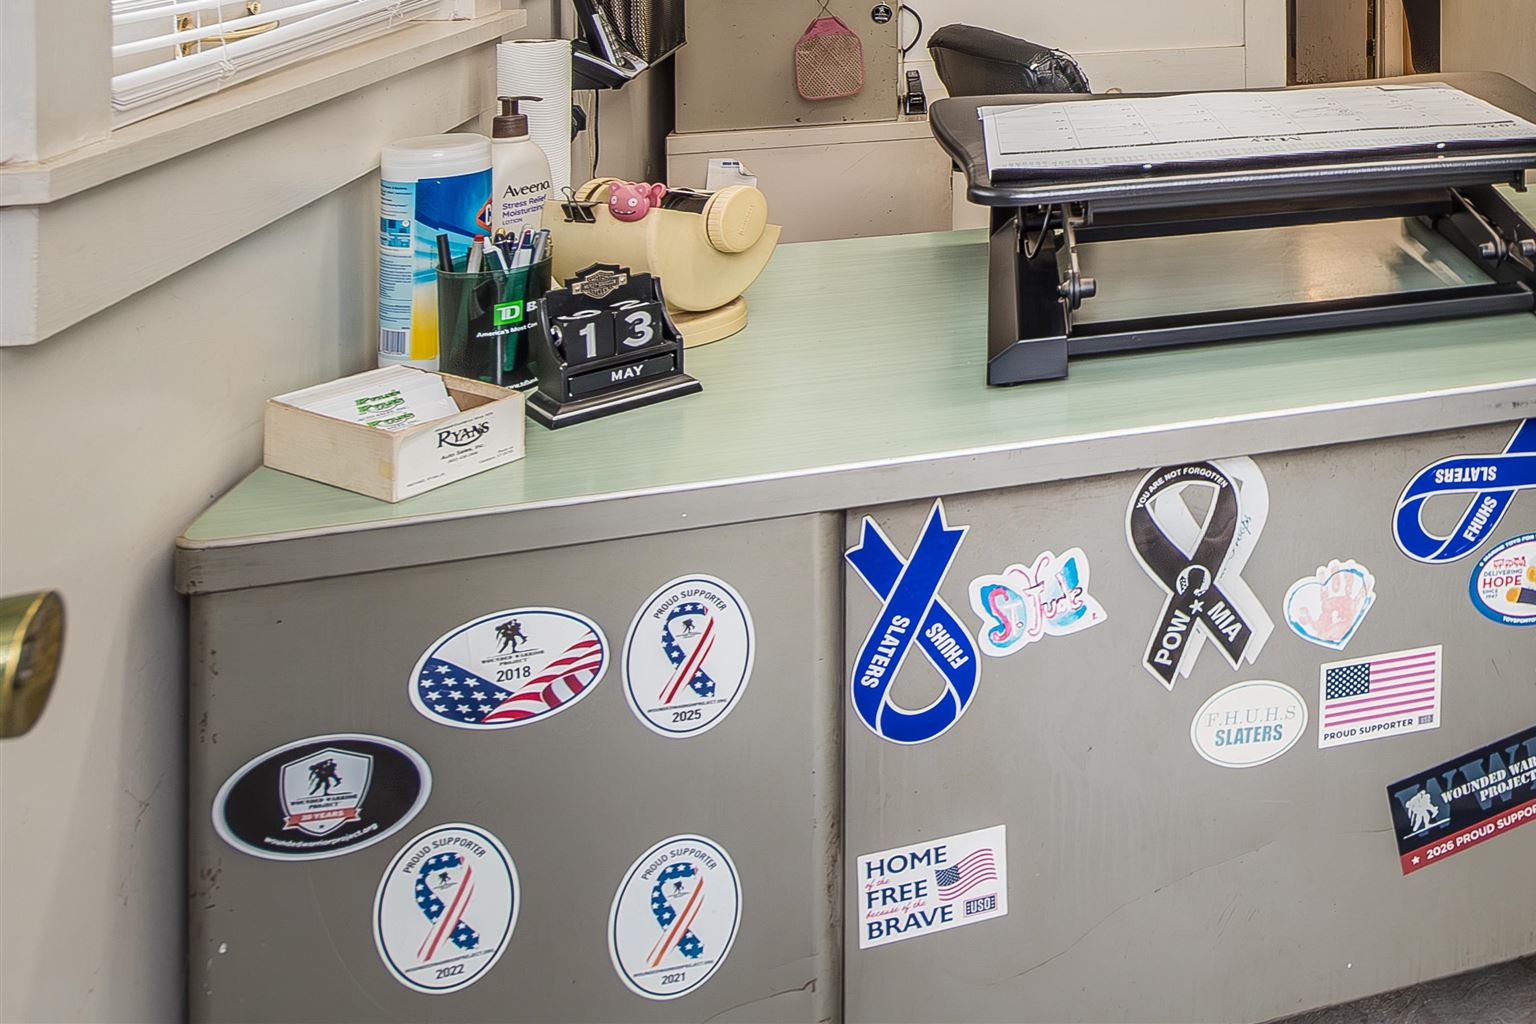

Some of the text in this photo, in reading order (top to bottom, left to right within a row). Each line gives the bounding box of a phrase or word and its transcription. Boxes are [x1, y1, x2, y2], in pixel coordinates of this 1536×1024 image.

[502, 194, 546, 210] Stress Relief
[496, 305, 520, 320] TD
[476, 325, 527, 338] America's Most
[579, 311, 654, 358] 1 3
[611, 365, 644, 381] MAY
[1435, 466, 1497, 484] SLATERS
[1136, 467, 1229, 509] YOU ARE NOT FORGOTTEN
[1463, 496, 1498, 542] FHUHS
[1483, 569, 1522, 577] DELIVERING
[1483, 575, 1522, 589] HOPE
[653, 589, 728, 619] PROUD SUPPORTER
[1207, 601, 1245, 643] MIA
[925, 623, 969, 670] FHUHS
[1154, 609, 1191, 666] POW
[860, 615, 911, 688] SLATERS
[496, 665, 531, 682] 2018
[672, 708, 702, 723] 2025
[1215, 724, 1283, 746] SLATERS
[1324, 718, 1413, 740] PROUD SUPPORTER
[1441, 768, 1506, 804] WOUNDED
[314, 810, 345, 820] YEARS
[1426, 840, 1454, 860] 2026
[1456, 824, 1496, 847] PROUD
[402, 836, 486, 874] PROUD SUPPORTER
[641, 848, 718, 880] PROUD SUPPORTER
[865, 845, 948, 879] HOME
[865, 877, 890, 891] of the
[866, 879, 928, 909] FREE
[866, 899, 926, 919] because of the
[970, 896, 991, 914] USO
[866, 904, 953, 940] BRAVE
[435, 963, 465, 979] 2022
[661, 972, 686, 985] 2021
